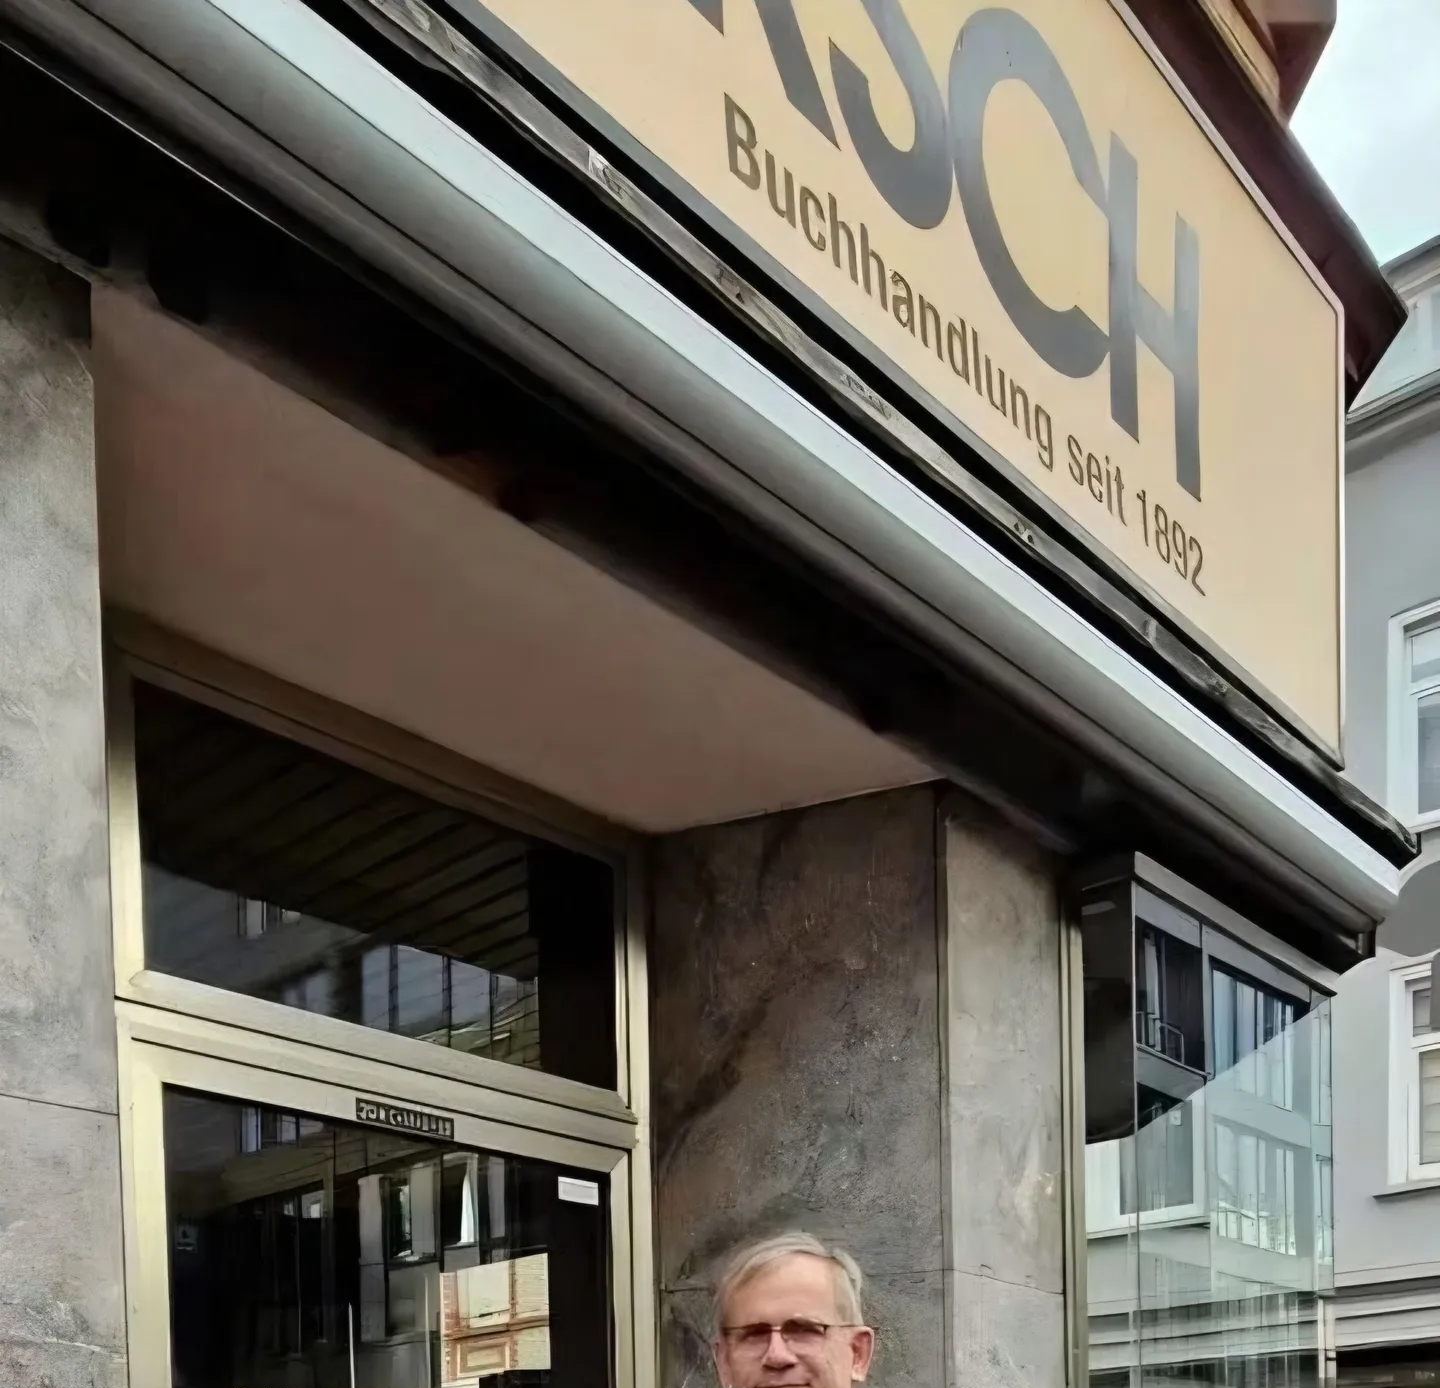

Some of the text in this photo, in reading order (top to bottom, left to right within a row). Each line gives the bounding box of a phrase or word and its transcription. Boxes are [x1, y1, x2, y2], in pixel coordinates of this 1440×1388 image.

[724, 92, 1206, 597] Buchhandlung seit 1892
